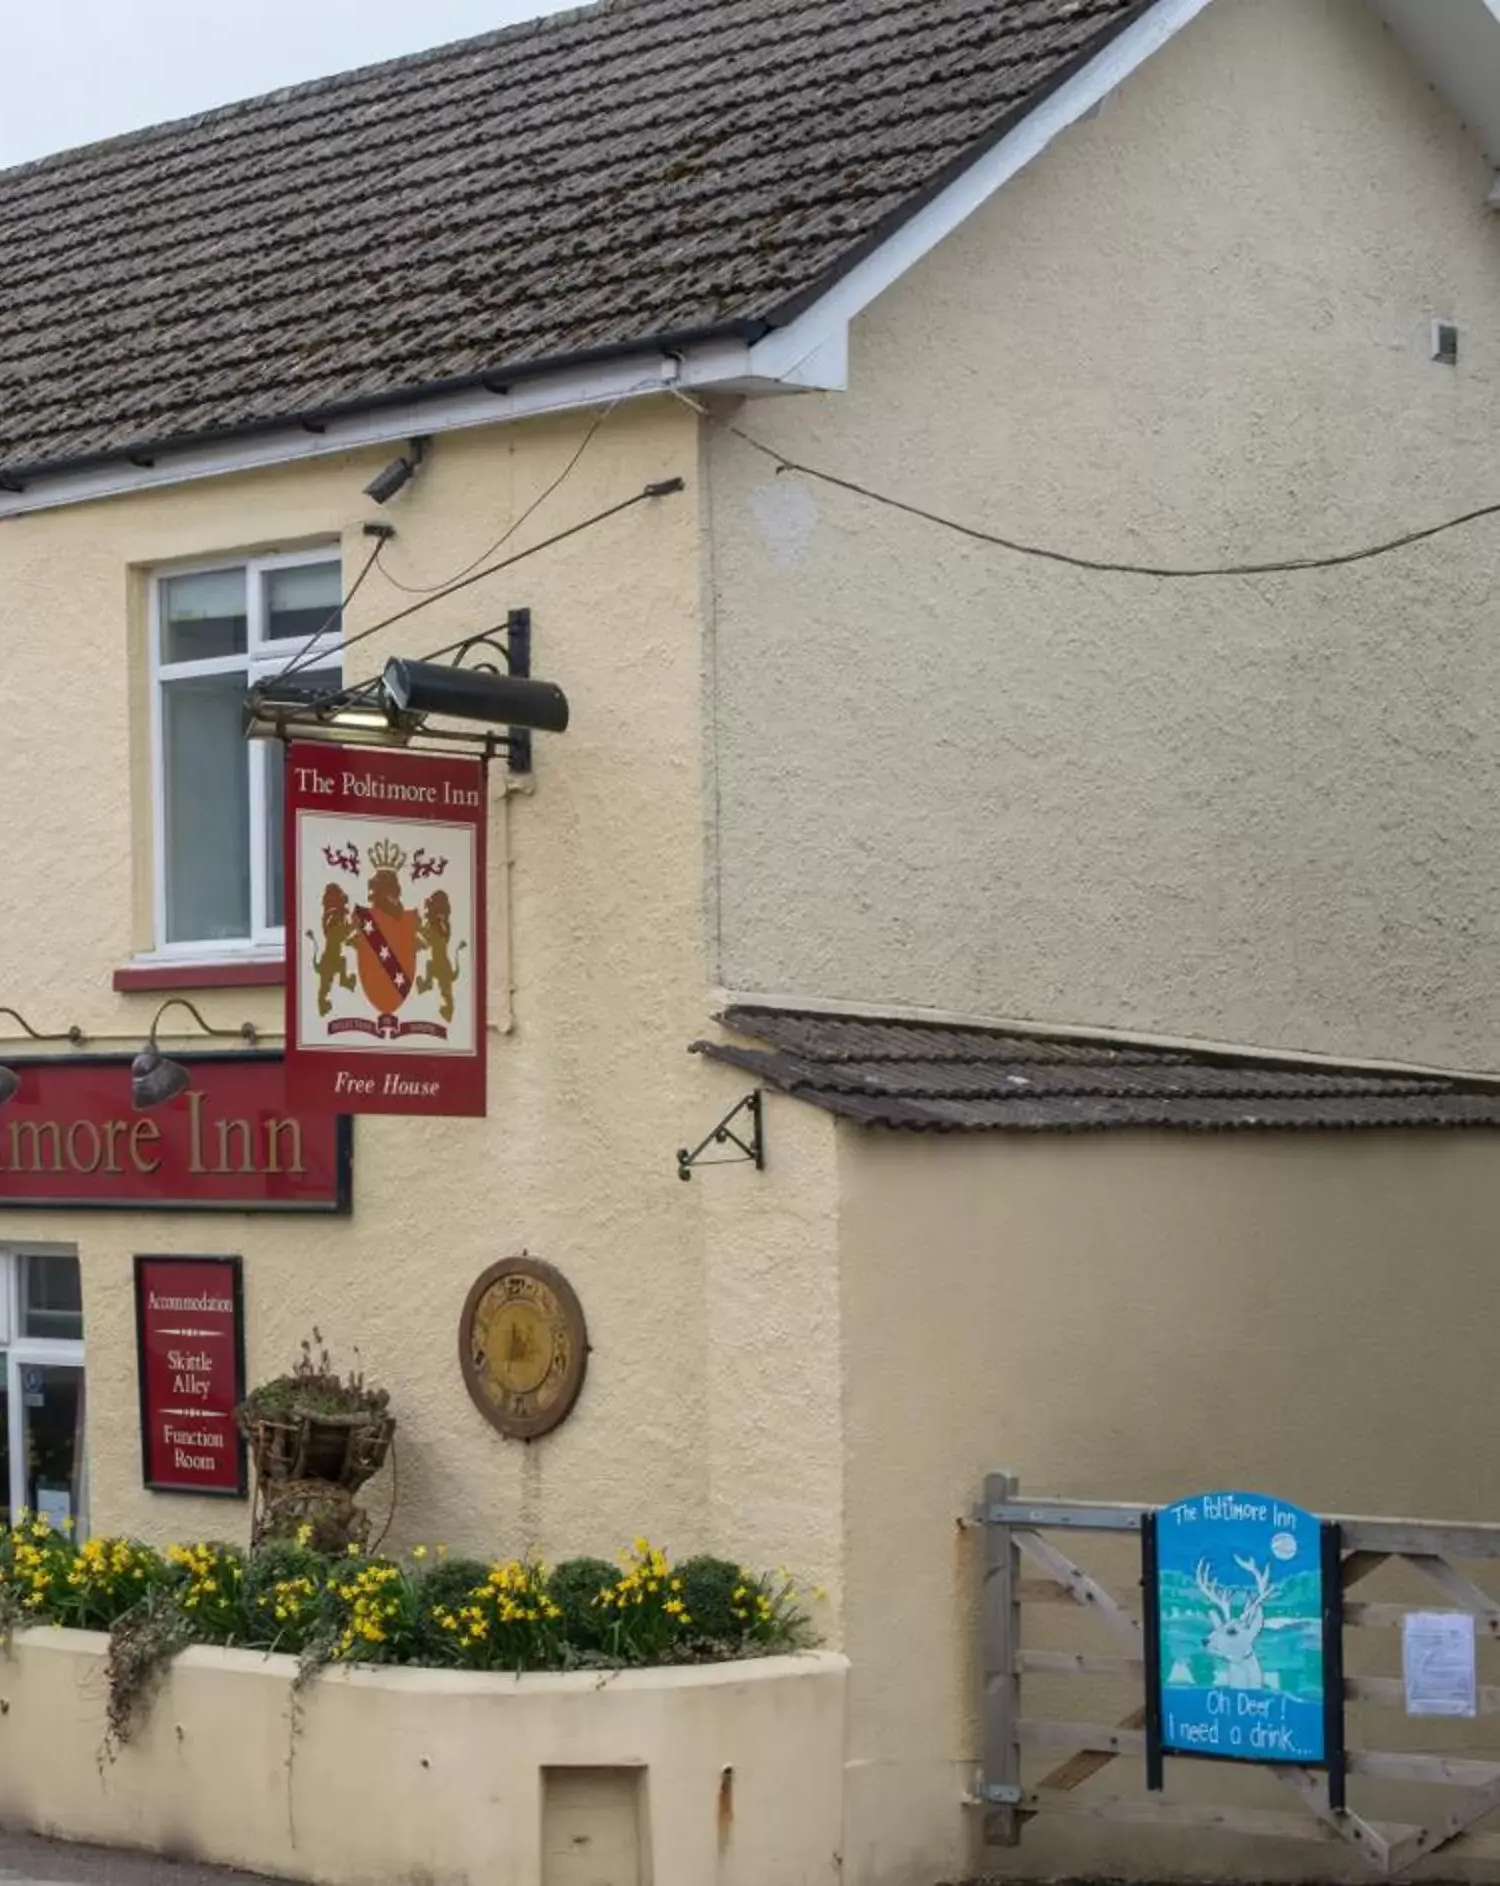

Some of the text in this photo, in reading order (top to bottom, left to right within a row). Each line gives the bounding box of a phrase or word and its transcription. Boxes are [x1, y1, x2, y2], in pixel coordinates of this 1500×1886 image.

[295, 767, 481, 807] The Poltimore Inn
[334, 1071, 440, 1098] Free House
[185, 1092, 309, 1177] Inn
[148, 1289, 233, 1313] Accommodation
[167, 1350, 213, 1371] Skittle
[172, 1374, 211, 1400] Alley
[163, 1424, 224, 1448] Function
[174, 1448, 216, 1471] Room
[1171, 1504, 1197, 1527] The
[1273, 1503, 1298, 1530] Inn
[1206, 1690, 1231, 1717] Oh
[1180, 1719, 1219, 1745] need
[1230, 1725, 1241, 1745] a
